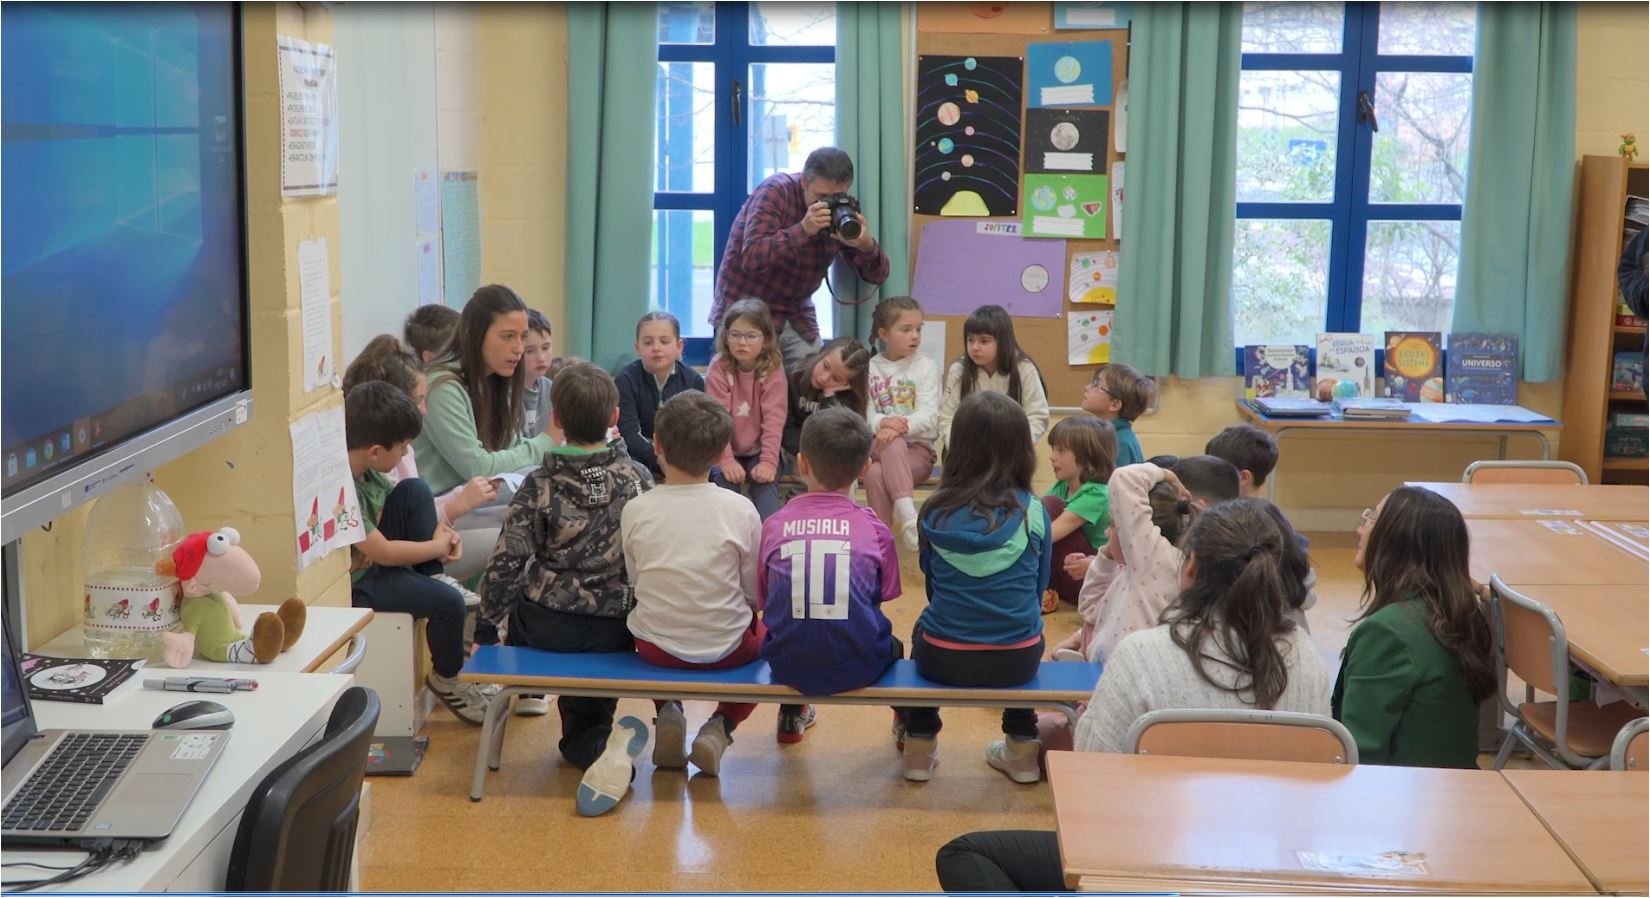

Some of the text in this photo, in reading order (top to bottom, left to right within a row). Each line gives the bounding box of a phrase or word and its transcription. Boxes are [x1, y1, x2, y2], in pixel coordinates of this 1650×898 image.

[1462, 359, 1502, 368] UNIVERSO
[783, 519, 850, 537] MUSIALA
[780, 539, 851, 620] 10
